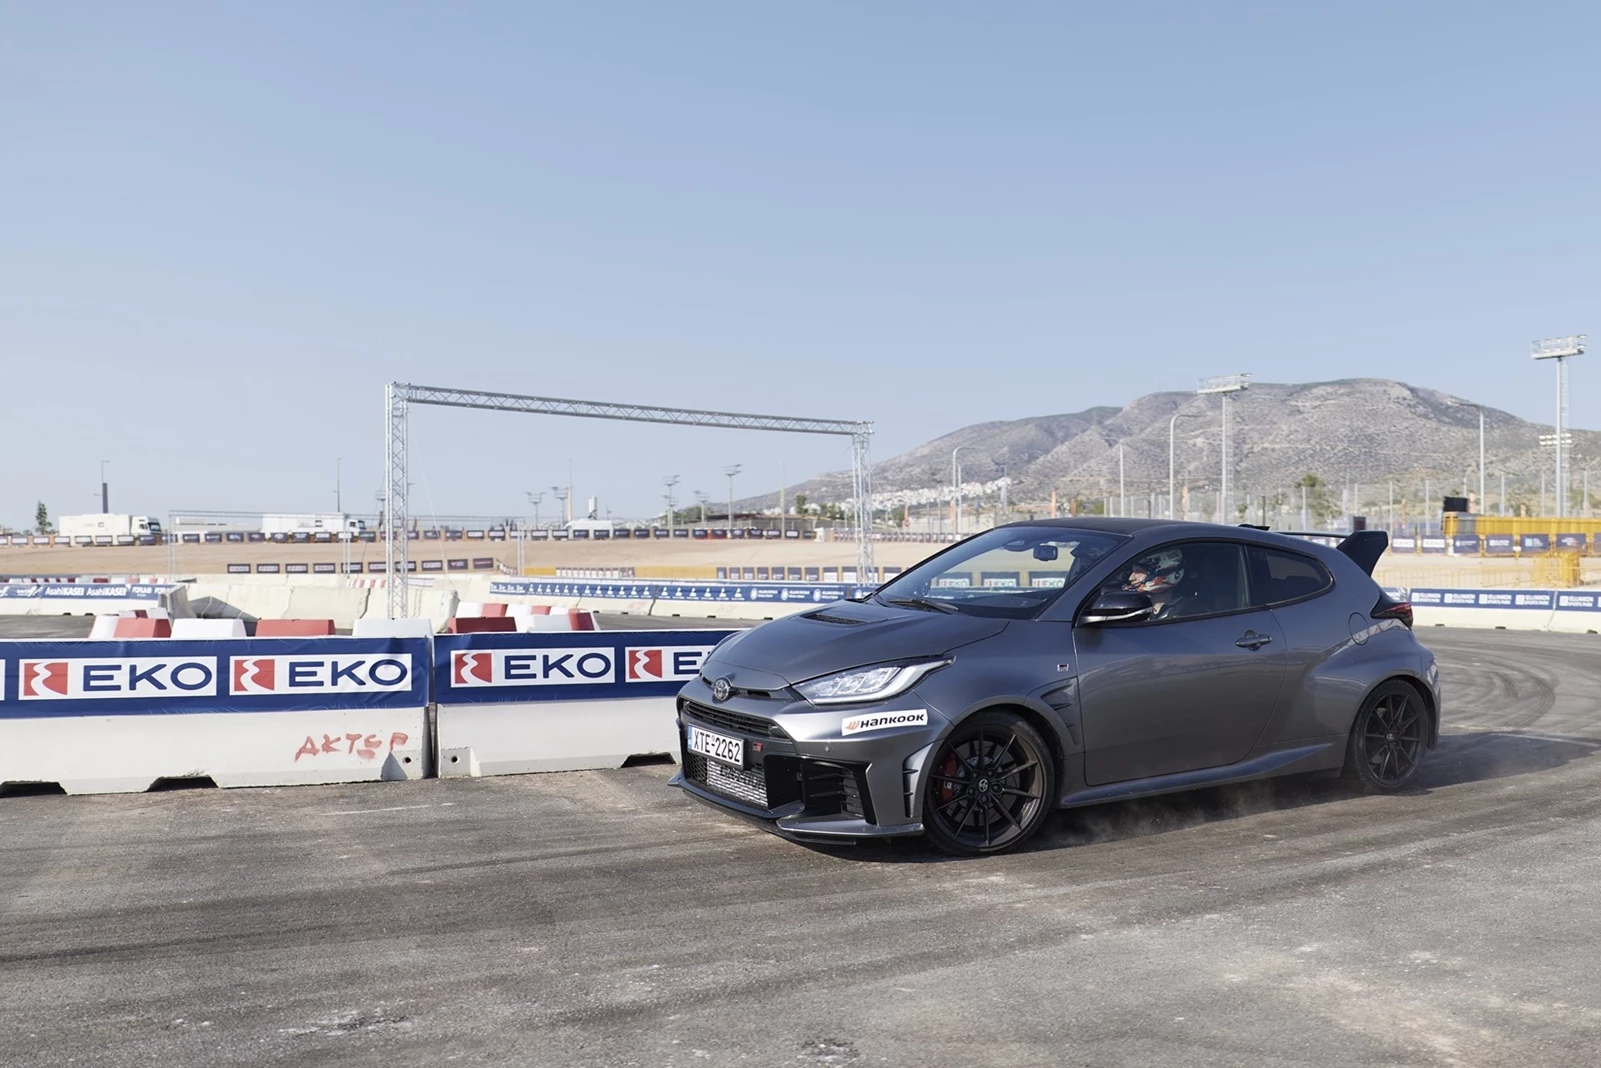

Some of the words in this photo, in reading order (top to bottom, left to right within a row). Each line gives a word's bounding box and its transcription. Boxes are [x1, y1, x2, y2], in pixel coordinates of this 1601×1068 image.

[83, 662, 213, 692] EKO
[288, 659, 408, 687] EKO
[504, 652, 611, 680] EKO
[694, 729, 741, 763] XTE-2262
